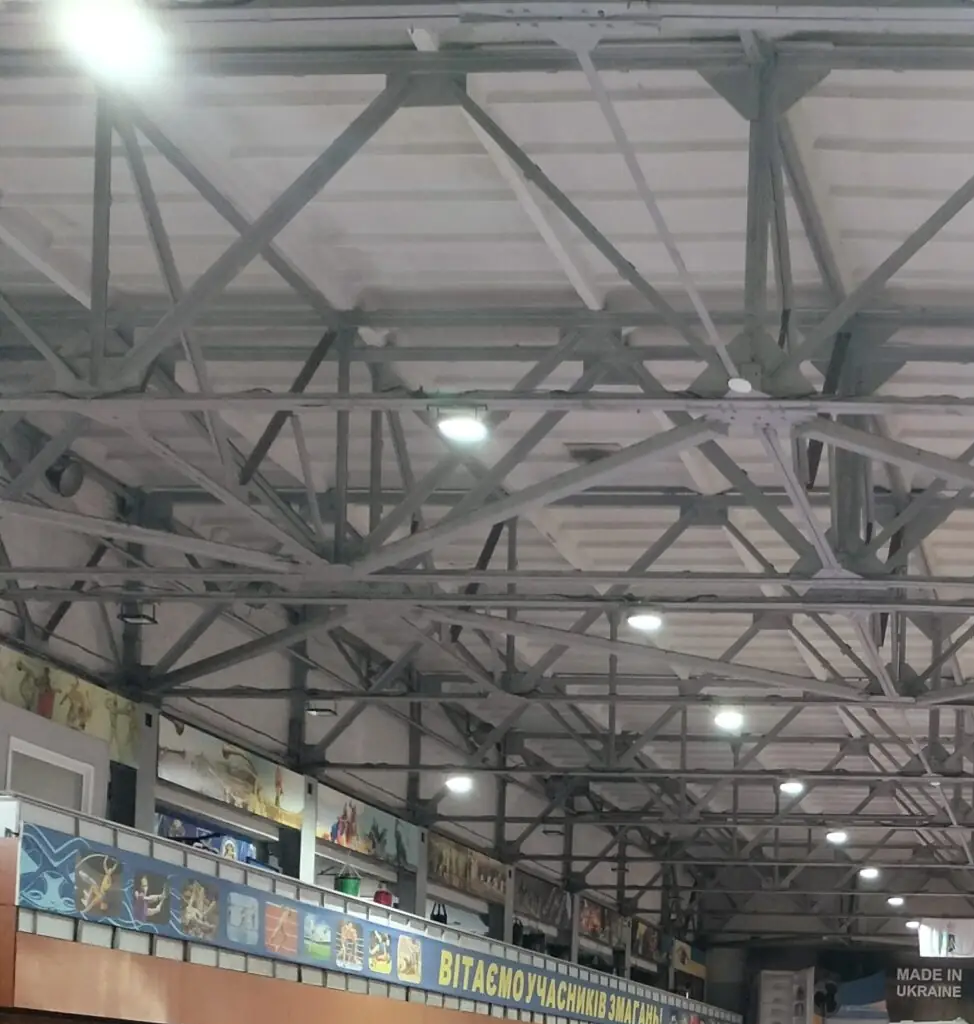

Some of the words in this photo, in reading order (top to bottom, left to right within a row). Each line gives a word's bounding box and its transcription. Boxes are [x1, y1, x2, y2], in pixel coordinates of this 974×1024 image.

[896, 968, 943, 981] MADE
[947, 968, 963, 982] IN
[438, 948, 524, 1001] ВІТАЄМО
[526, 972, 607, 1019] УЧАСНИКІВ
[896, 985, 962, 998] UKRAINE
